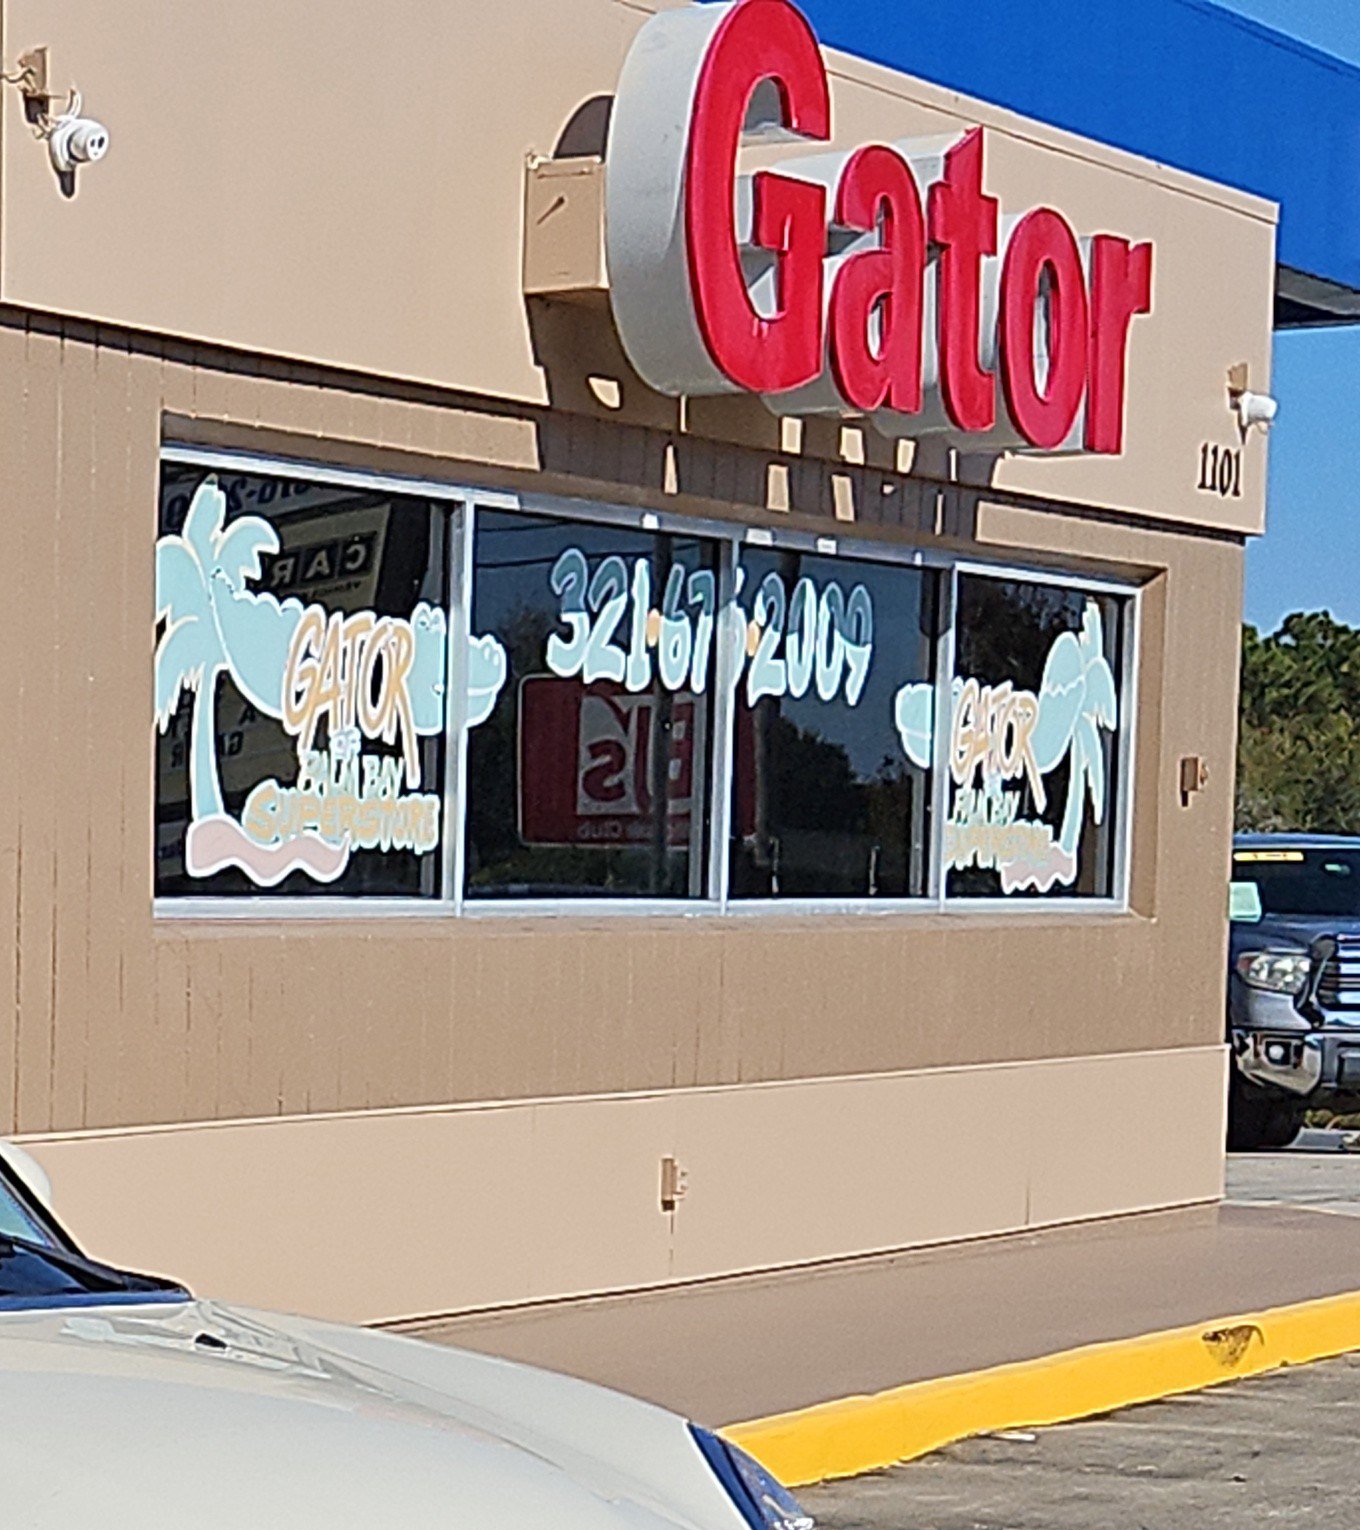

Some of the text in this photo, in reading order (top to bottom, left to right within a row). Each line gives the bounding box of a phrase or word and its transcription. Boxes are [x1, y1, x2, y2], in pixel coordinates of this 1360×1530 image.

[685, 0, 1152, 455] Gator
[1198, 441, 1241, 498] 1101
[282, 603, 421, 789] GATOR
[950, 677, 1047, 816] GATOR
